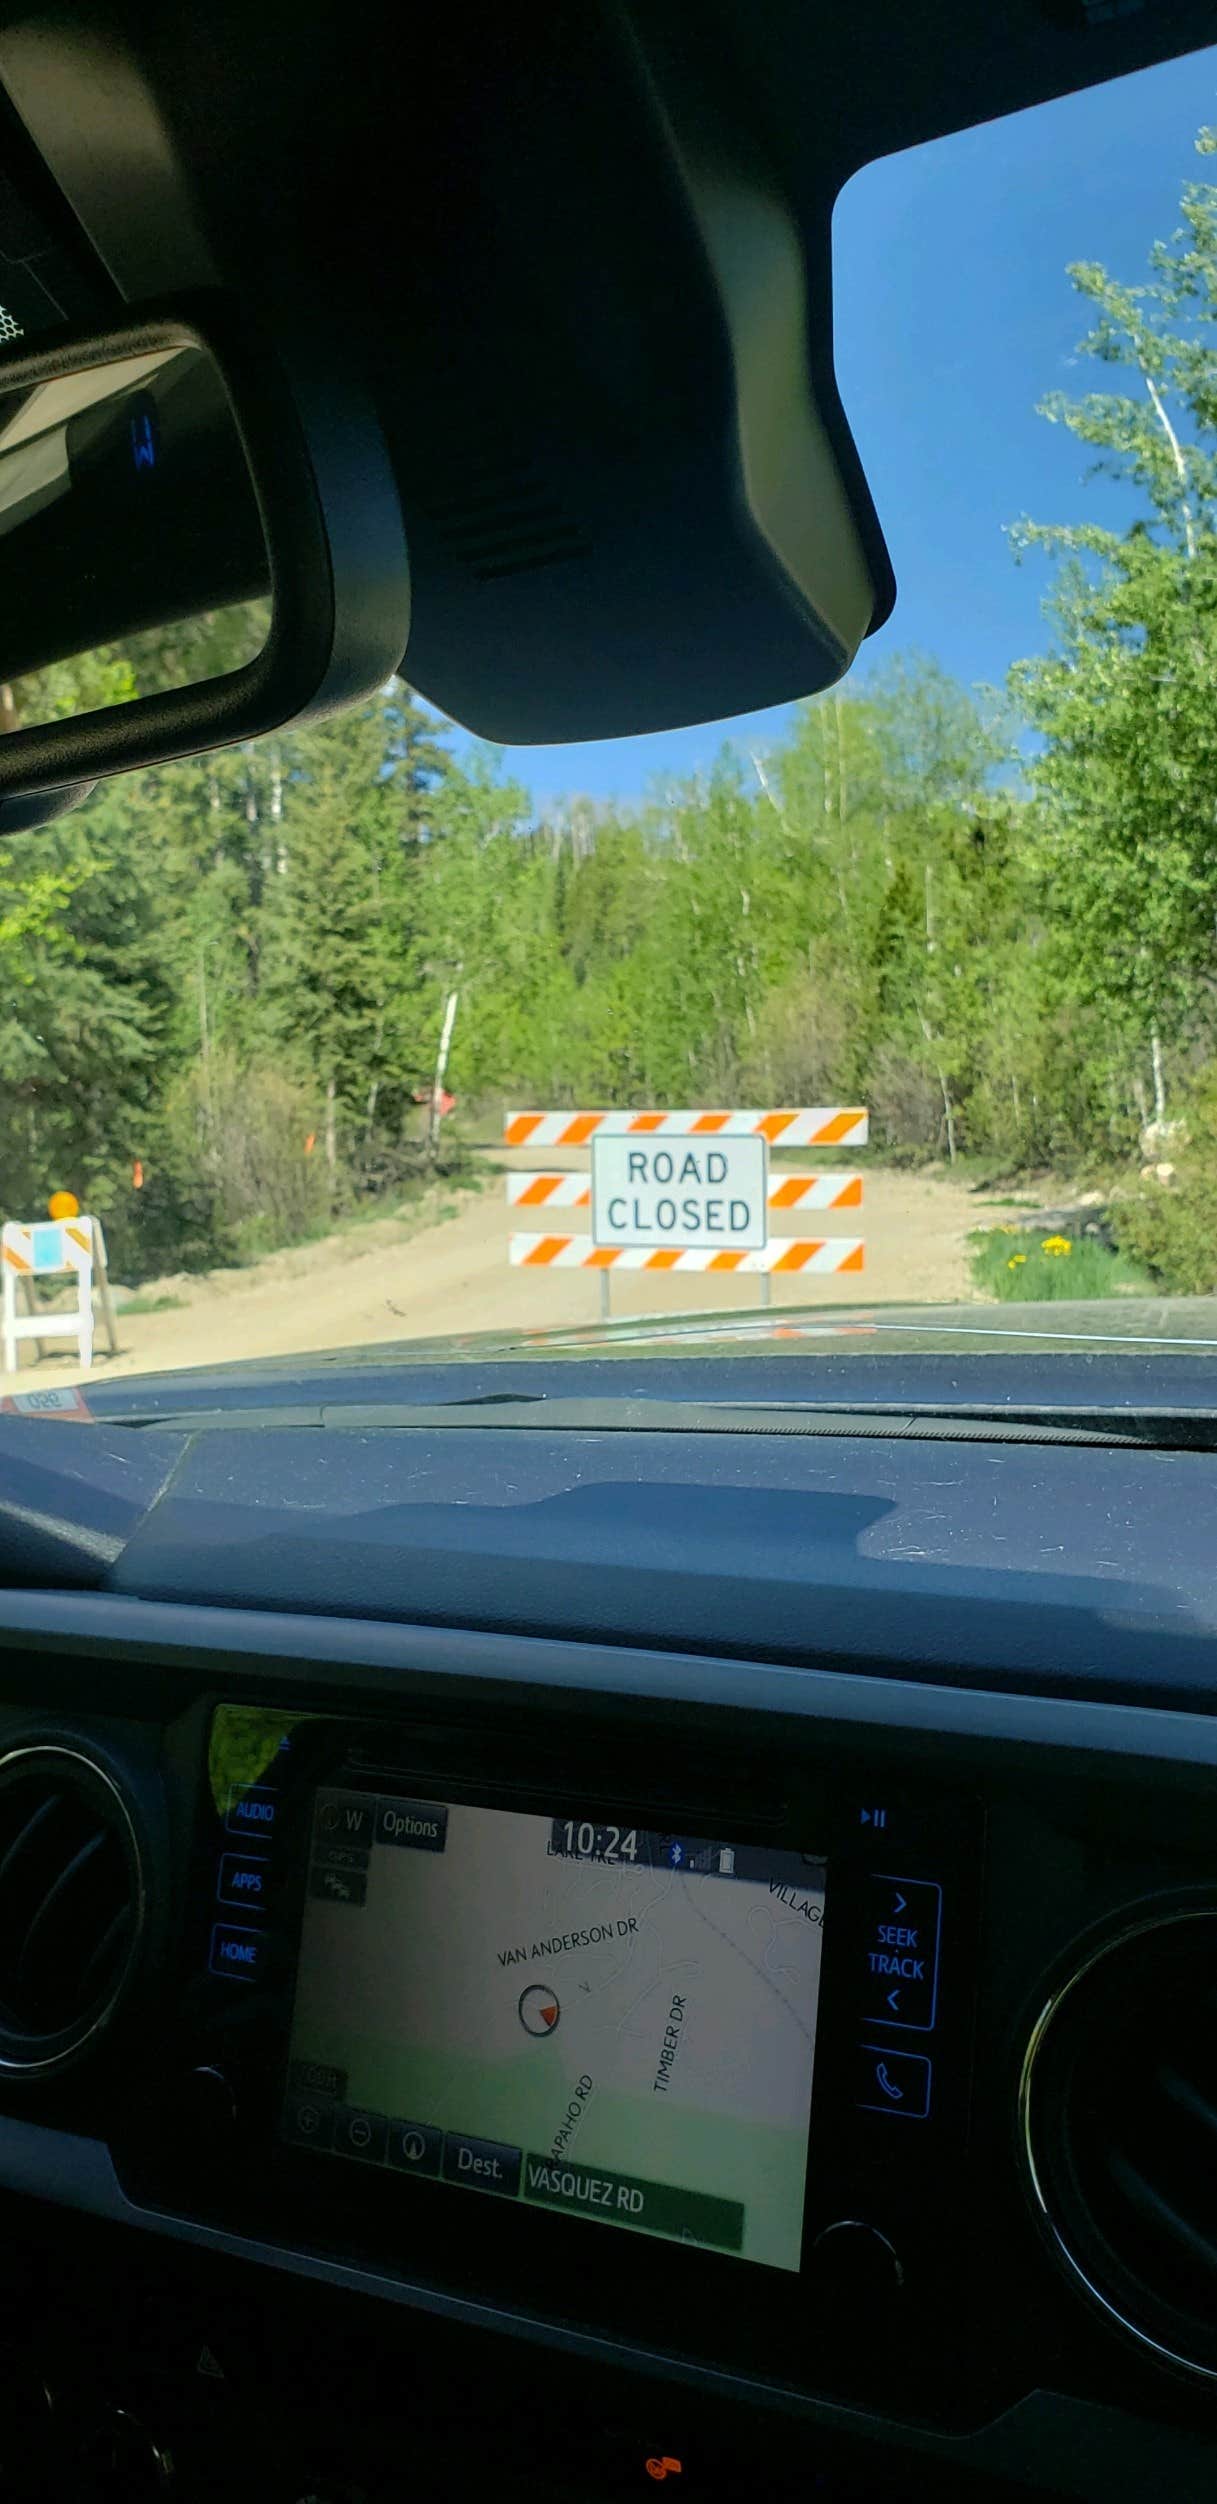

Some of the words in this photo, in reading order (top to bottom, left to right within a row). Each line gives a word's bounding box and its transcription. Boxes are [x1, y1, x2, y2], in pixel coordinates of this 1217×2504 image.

[628, 1151, 728, 1184] ROAD
[607, 1198, 751, 1232] CLOSED
[236, 1802, 275, 1822] AUDIO
[344, 1810, 365, 1831] W
[383, 1810, 439, 1839] Options
[563, 1820, 638, 1861] 10:24
[231, 1872, 263, 1892] APPS
[497, 1946, 528, 1967] VAN
[531, 1925, 614, 1960] ANDERSON
[617, 1917, 640, 1935] DR
[876, 1924, 919, 1949] SEEK
[219, 1940, 257, 1964] HOME
[867, 1952, 925, 1981] TRACK
[653, 2026, 681, 2093] TIMBER
[670, 1994, 688, 2021] DR
[575, 2074, 593, 2101] RD
[457, 2148, 503, 2179] Dest.
[528, 2162, 613, 2206] VASQUEZ
[617, 2185, 645, 2214] RD
